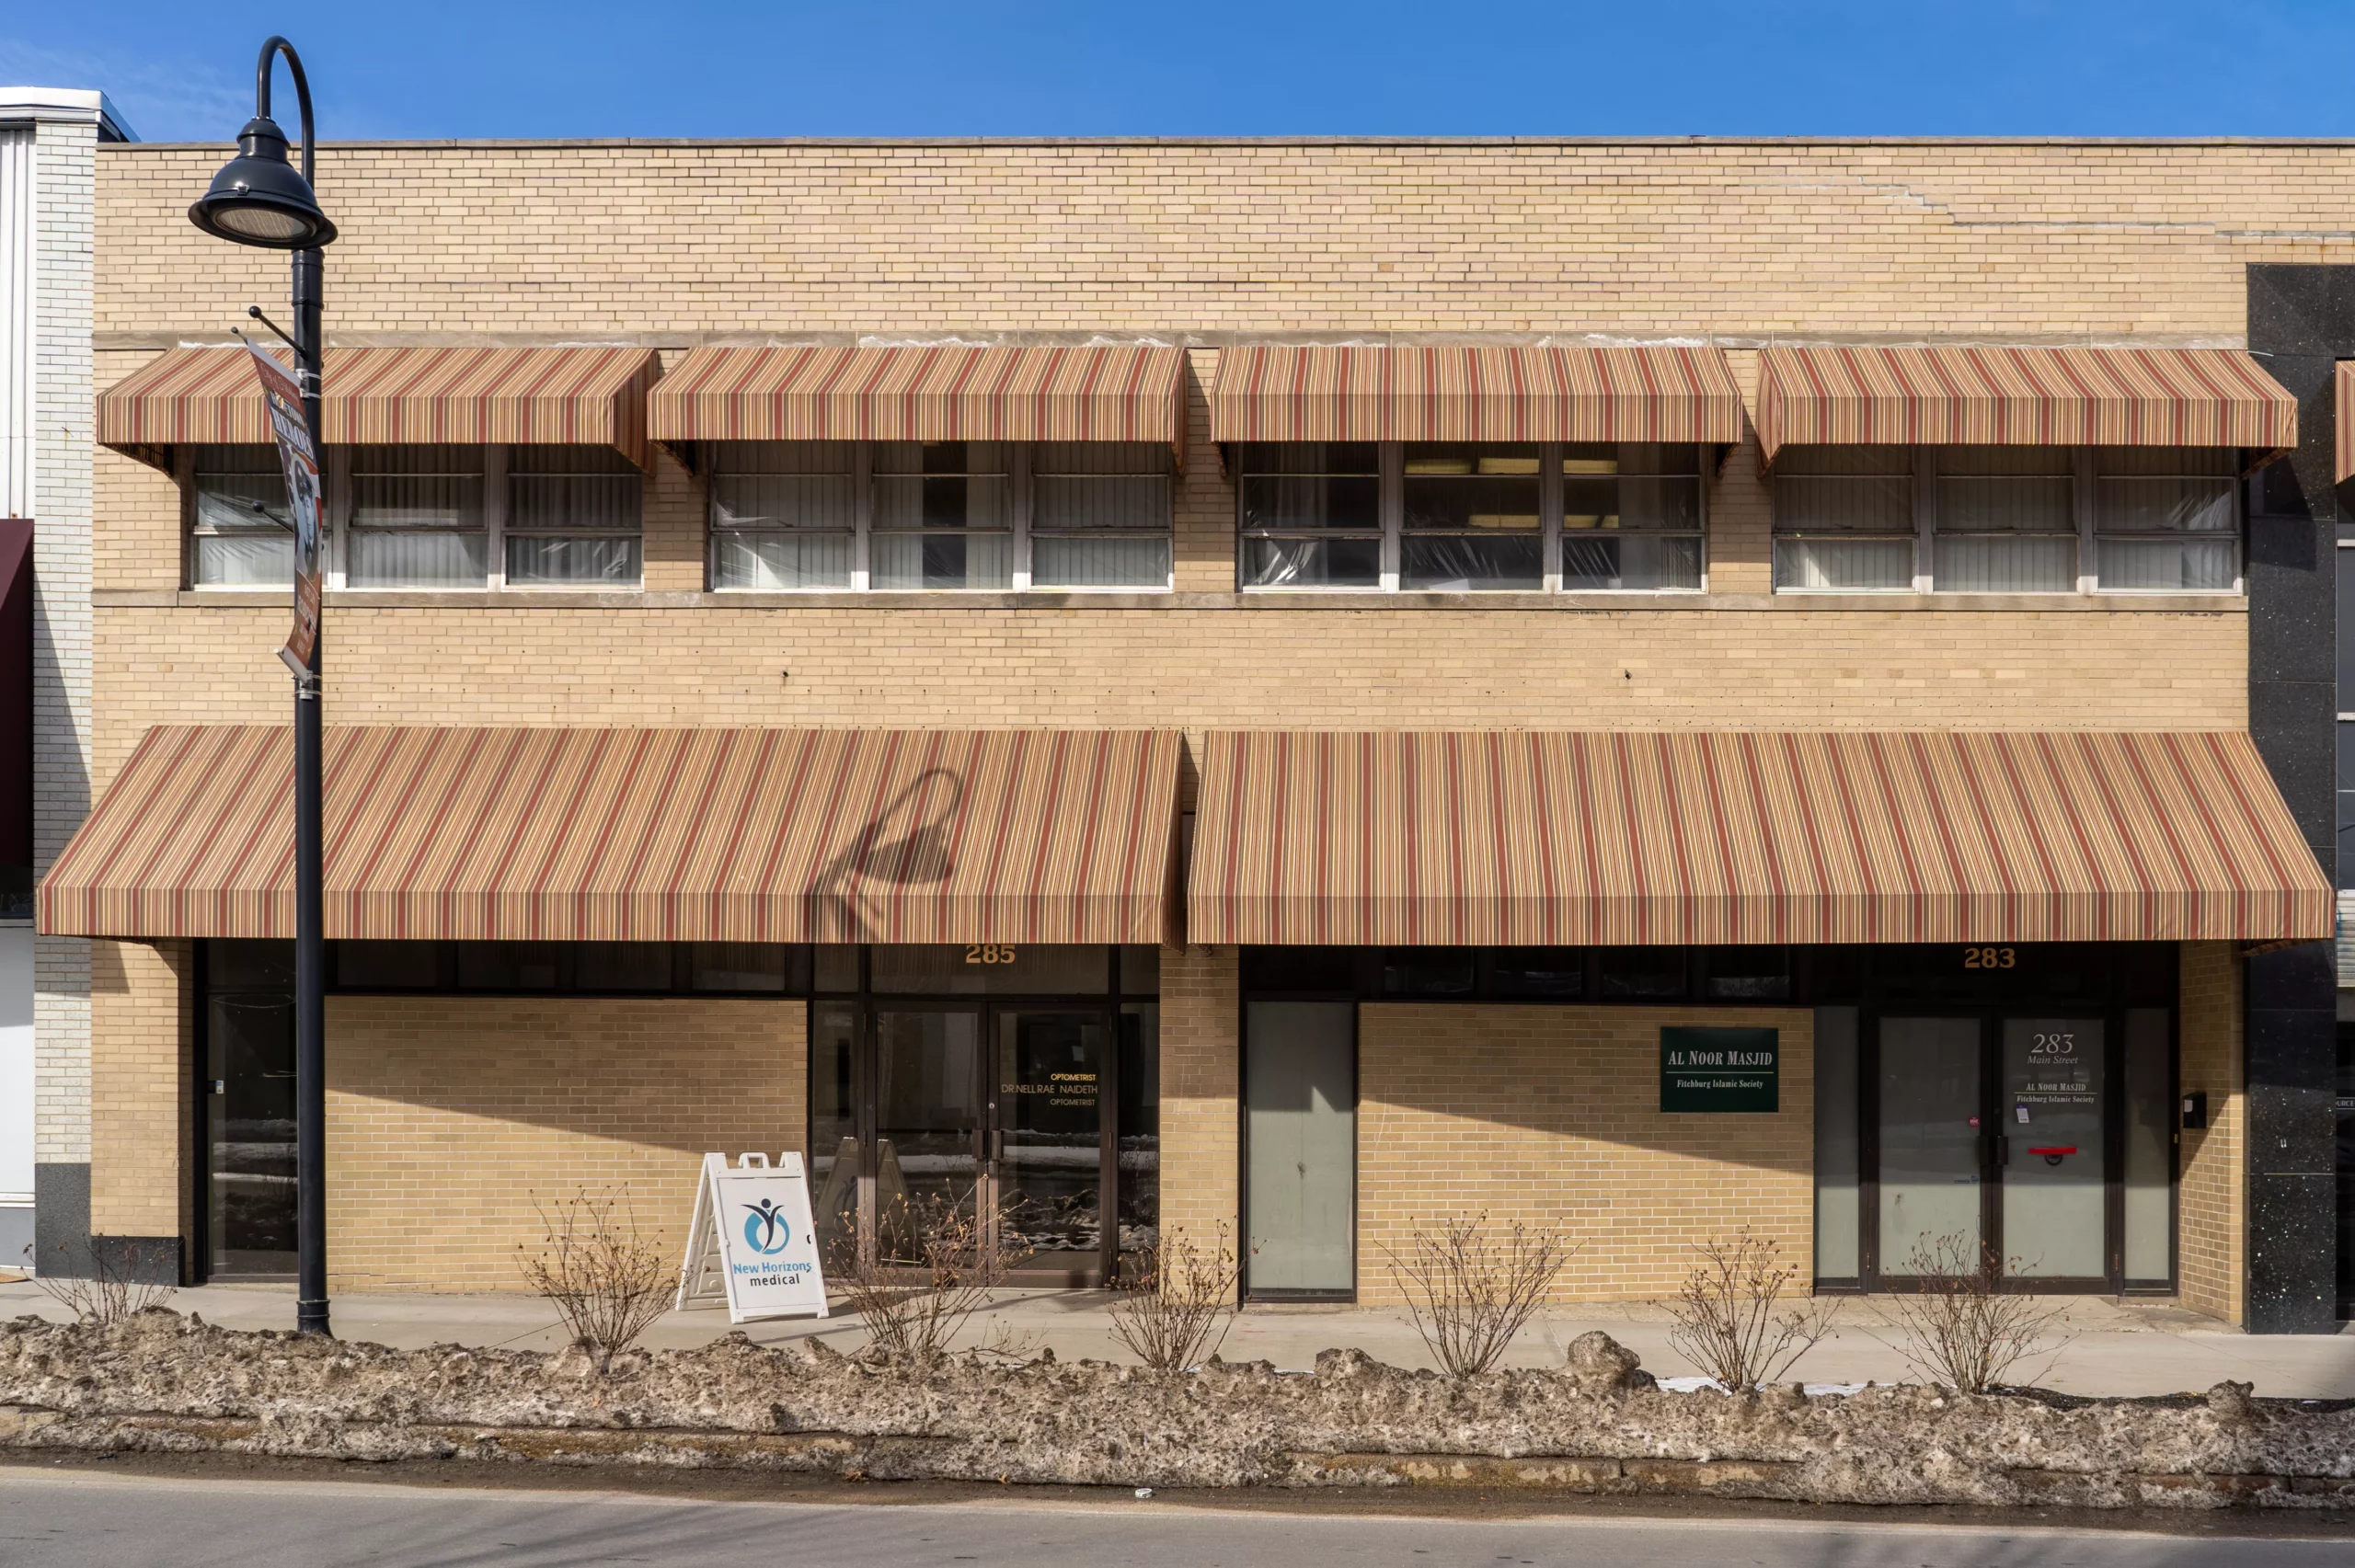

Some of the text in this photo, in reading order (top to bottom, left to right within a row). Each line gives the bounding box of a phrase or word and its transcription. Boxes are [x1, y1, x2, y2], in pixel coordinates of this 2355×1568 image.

[965, 944, 1016, 964] 285
[1964, 947, 2016, 968] 283
[2030, 1034, 2074, 1054] 283
[1668, 1050, 1773, 1066] AL NOOR MASJID
[2027, 1055, 2078, 1064] Main Street
[1051, 1073, 1097, 1082] OPTOMETRIST
[1060, 1084, 1097, 1094] NAIDETH
[1677, 1079, 1763, 1089] Fitchburg Islamic Society
[2026, 1082, 2086, 1092] AL NOOR MASJID
[1050, 1098, 1096, 1106] OPTOMETRIST
[2073, 1095, 2095, 1104] Society
[2335, 1099, 2355, 1107] URCE
[733, 1262, 811, 1274] New Horizons
[750, 1274, 799, 1286] medical
